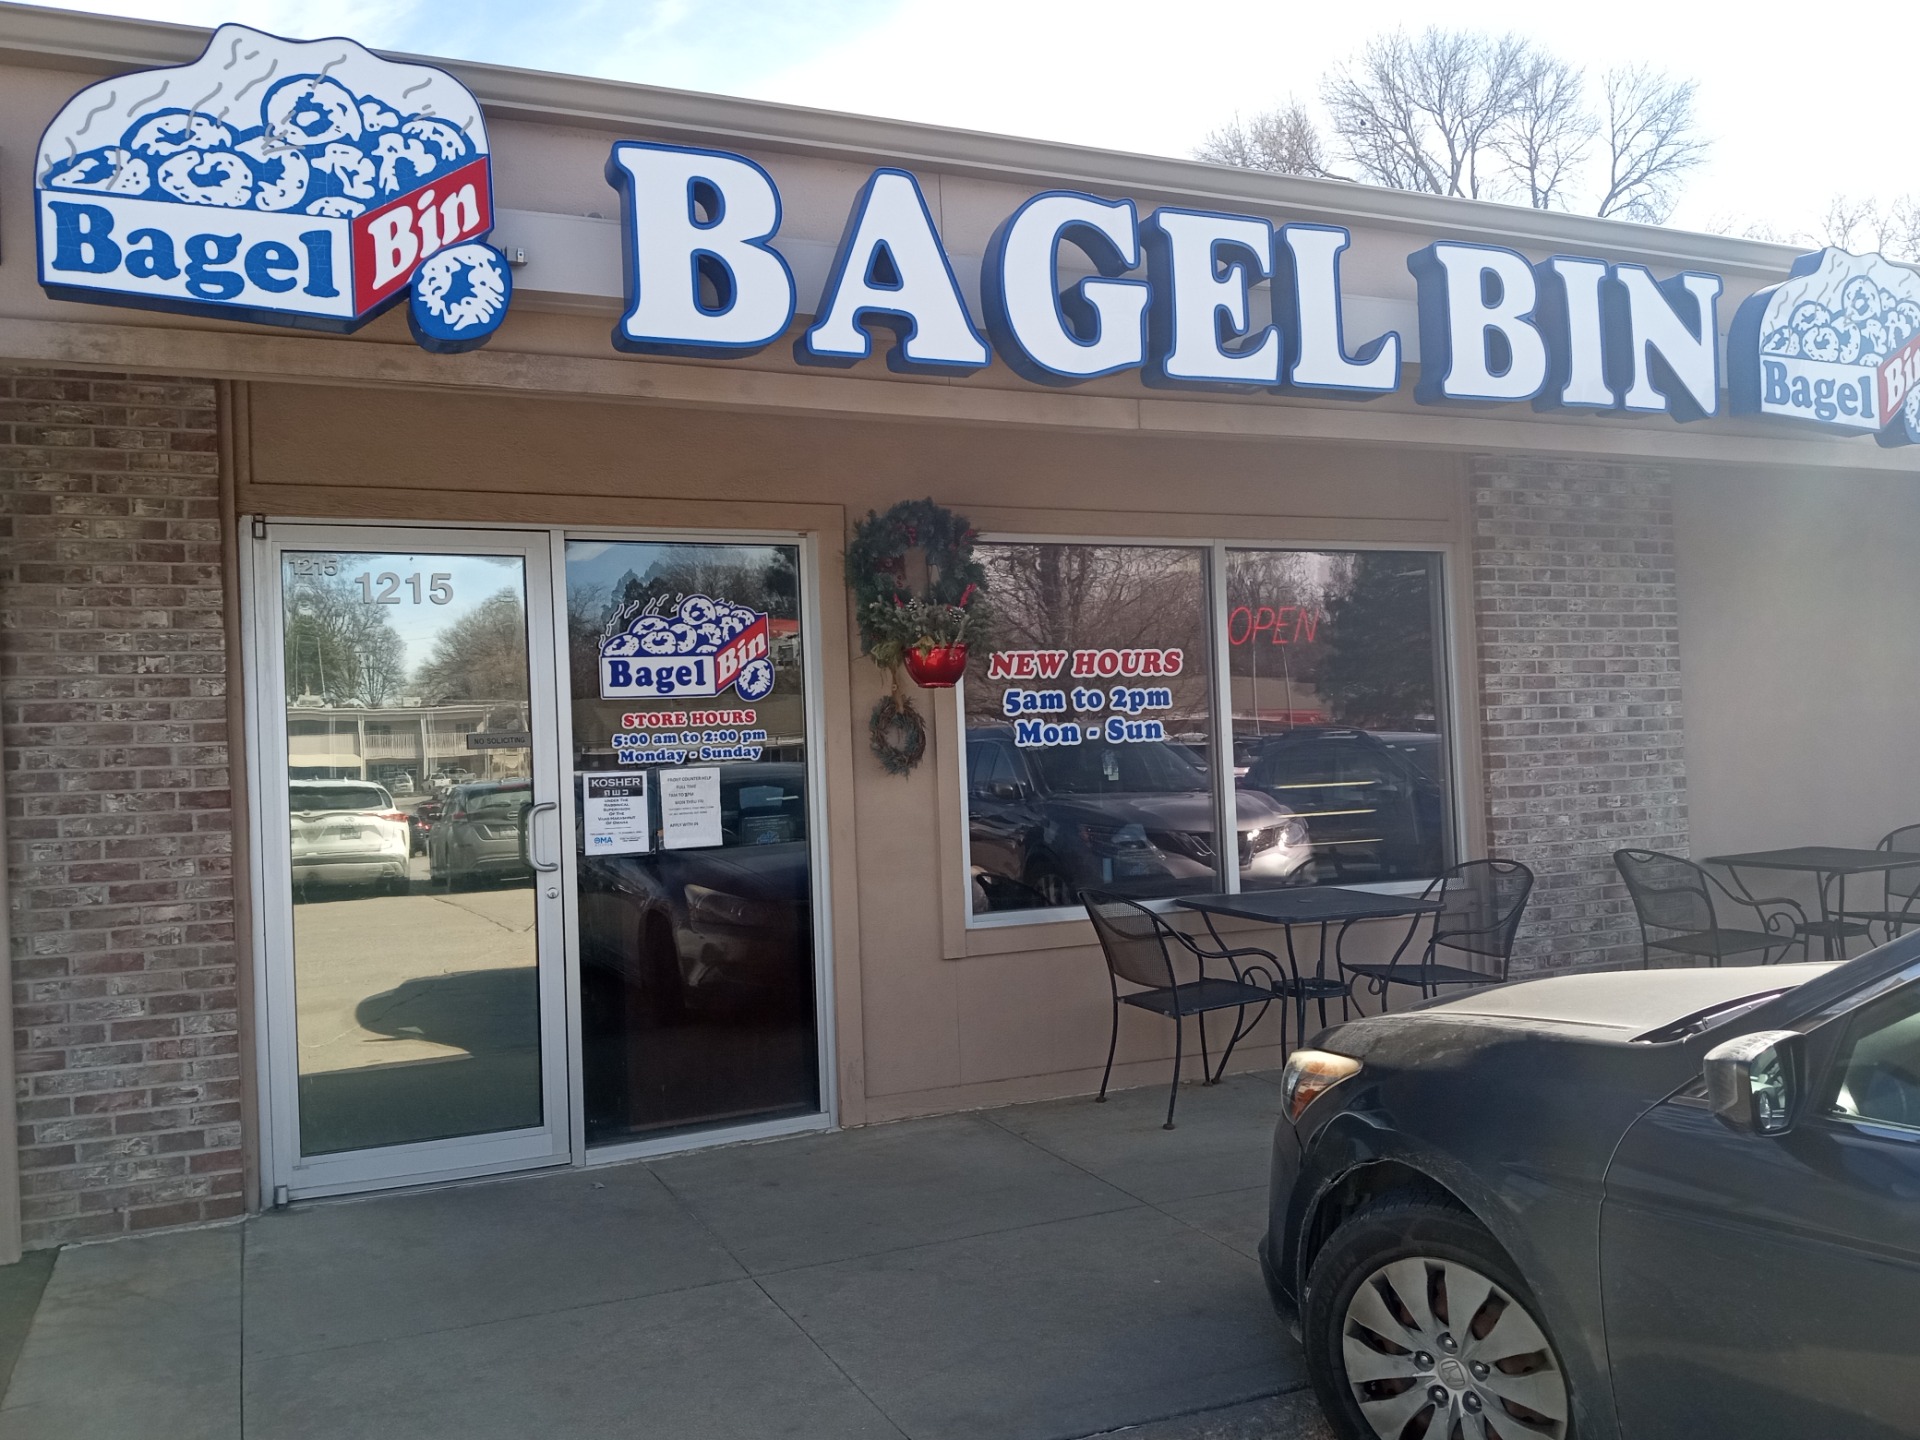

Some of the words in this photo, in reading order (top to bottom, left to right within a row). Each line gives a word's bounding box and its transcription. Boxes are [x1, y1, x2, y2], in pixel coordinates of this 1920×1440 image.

[48, 200, 341, 301] Bagel
[367, 181, 480, 291] Bin
[610, 139, 1401, 394] BAGEL
[1430, 239, 1724, 418] BIN
[1762, 359, 1875, 421] Bagel
[289, 559, 339, 577] 1215
[354, 572, 454, 606] 1215
[1228, 606, 1321, 646] OPEN
[608, 659, 707, 694] Bagel
[717, 632, 767, 684] Bin
[990, 652, 1066, 677] NEW
[1072, 651, 1182, 676] HOURS
[1005, 690, 1064, 714] 5am
[1073, 689, 1104, 709] to
[1111, 688, 1171, 713] 2pm
[623, 713, 686, 728] STORE
[691, 710, 755, 726] HOURS
[1016, 721, 1080, 744] Mon
[1107, 719, 1163, 741] Sun
[486, 736, 526, 745] SOLICITING
[613, 734, 648, 747] 5:00
[653, 734, 677, 745] am
[682, 732, 699, 743] to
[704, 730, 737, 744] 2:00
[742, 730, 766, 744] pm
[620, 750, 685, 764] Monday
[701, 746, 762, 760] Sunday
[591, 777, 641, 788] KOSHER
